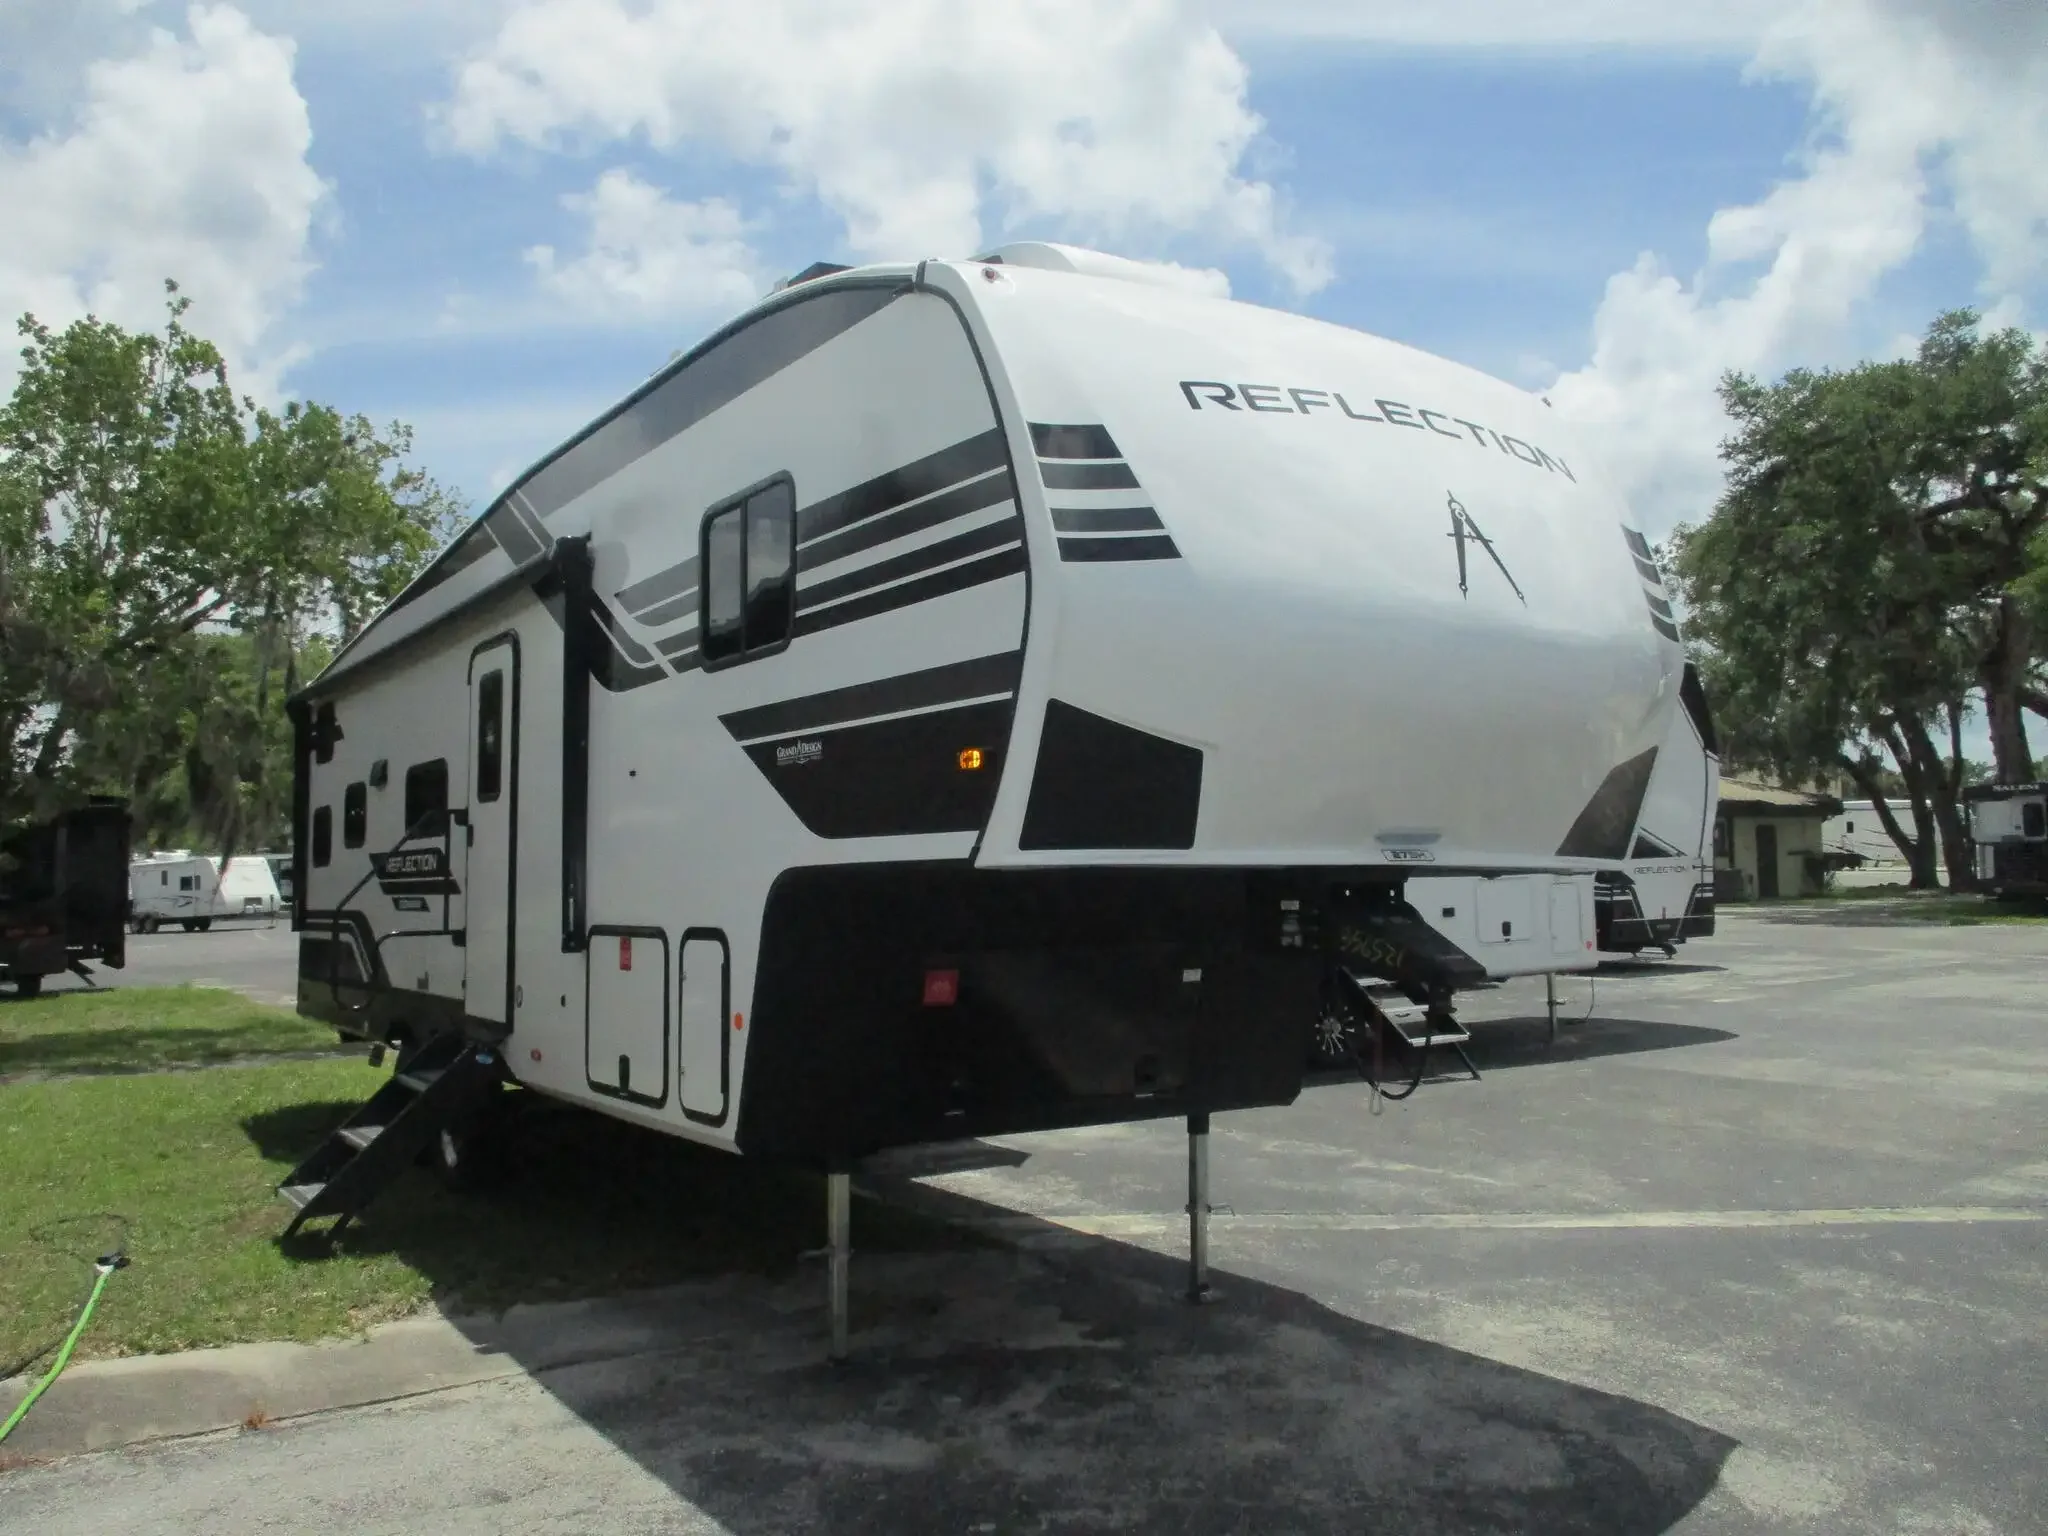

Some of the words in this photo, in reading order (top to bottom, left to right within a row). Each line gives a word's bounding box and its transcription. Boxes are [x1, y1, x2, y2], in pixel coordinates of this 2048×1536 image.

[1179, 380, 1577, 484] REFLECTION
[801, 741, 823, 754] DESIGN
[385, 854, 438, 873] REFLECTION
[1634, 864, 1688, 875] REFLECTION
